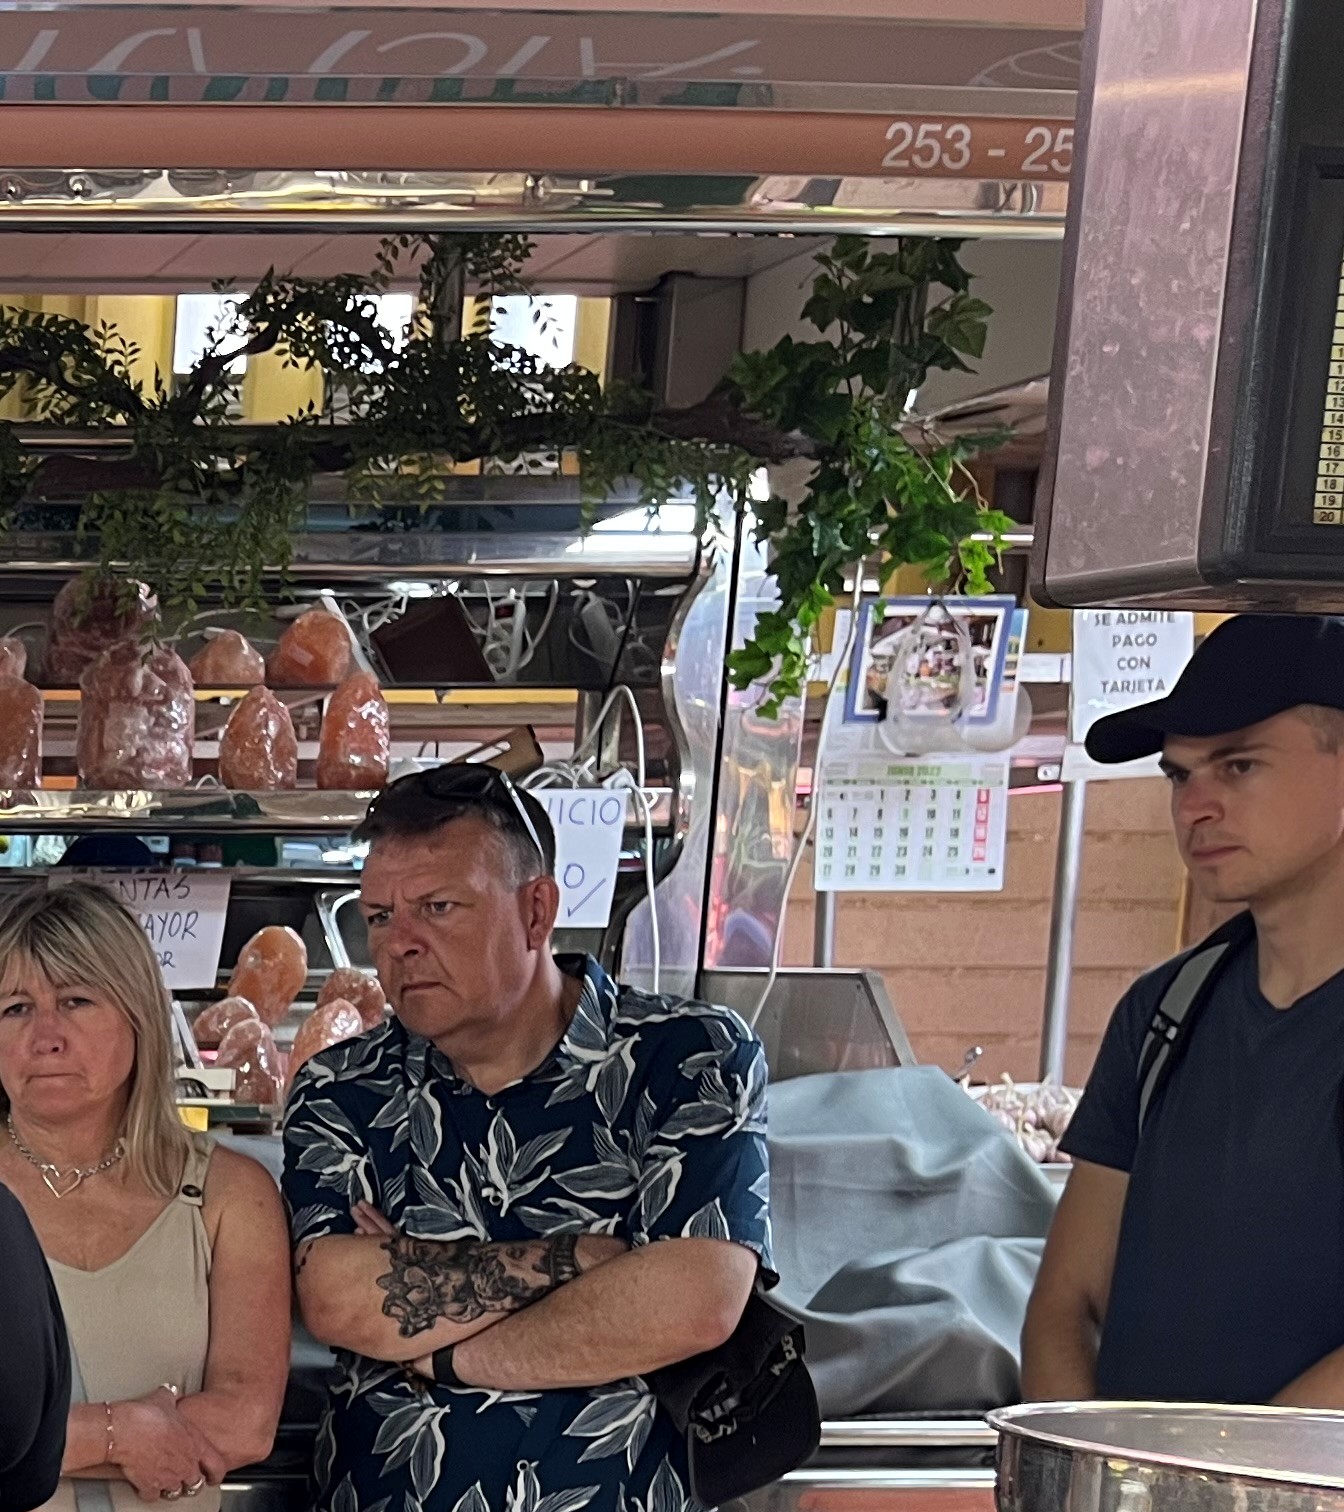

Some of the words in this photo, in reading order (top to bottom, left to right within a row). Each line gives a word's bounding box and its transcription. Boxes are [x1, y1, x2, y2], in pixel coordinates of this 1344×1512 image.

[882, 121, 972, 170] 253
[1095, 613, 1111, 626] SE
[1116, 612, 1176, 626] ADMITE
[1112, 633, 1158, 648] PAGO
[1117, 656, 1151, 671] CON
[1101, 679, 1166, 694] TARJETA
[118, 875, 191, 900] NTAS
[138, 911, 199, 944] AYOR
